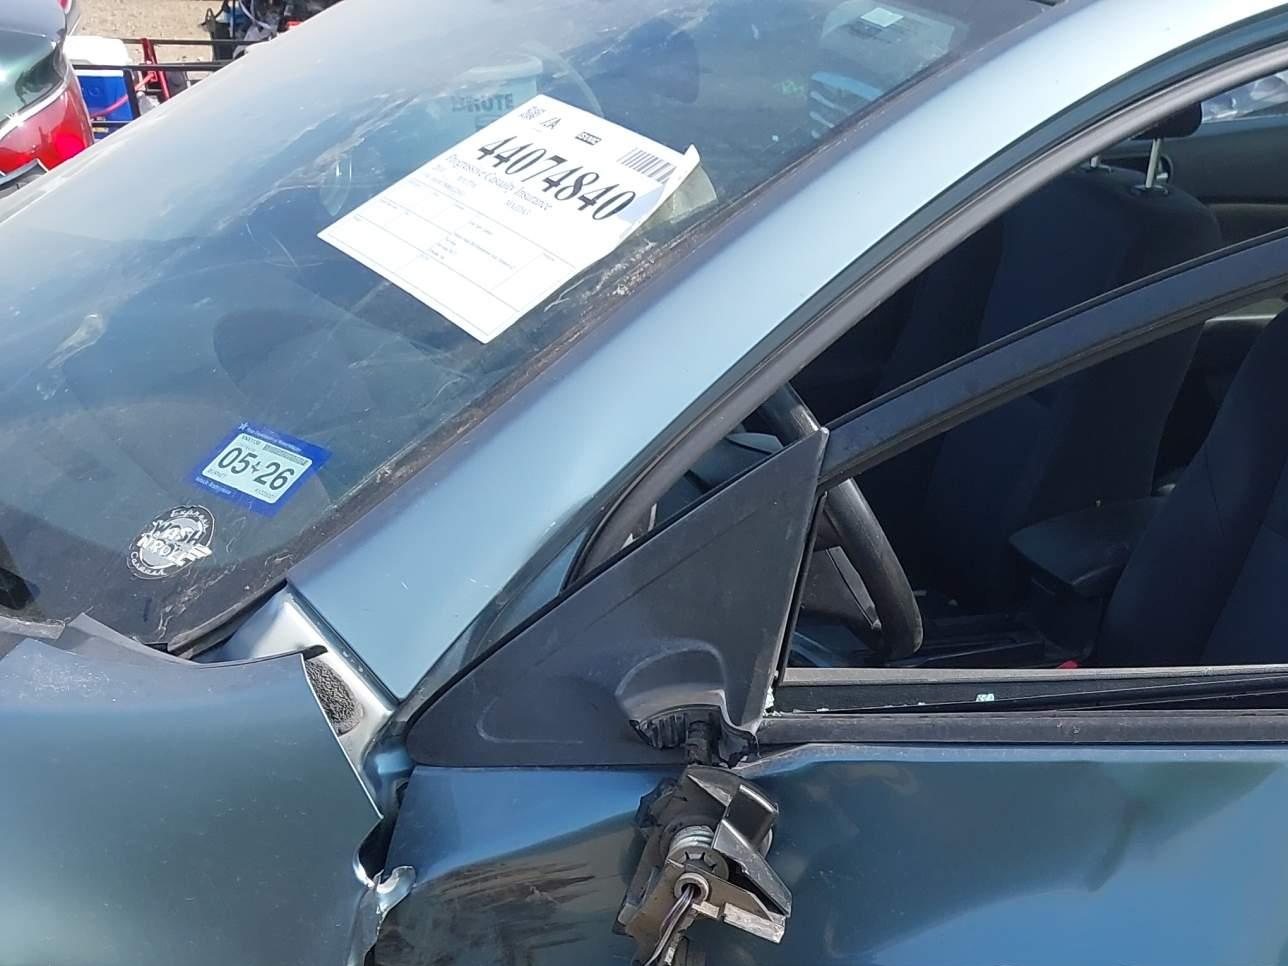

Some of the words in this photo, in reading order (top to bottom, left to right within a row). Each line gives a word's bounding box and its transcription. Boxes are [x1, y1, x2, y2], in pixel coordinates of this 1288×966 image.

[477, 136, 636, 220] 44074840
[219, 447, 257, 474] 05
[254, 462, 295, 490] 26
[153, 520, 207, 544] WASH
